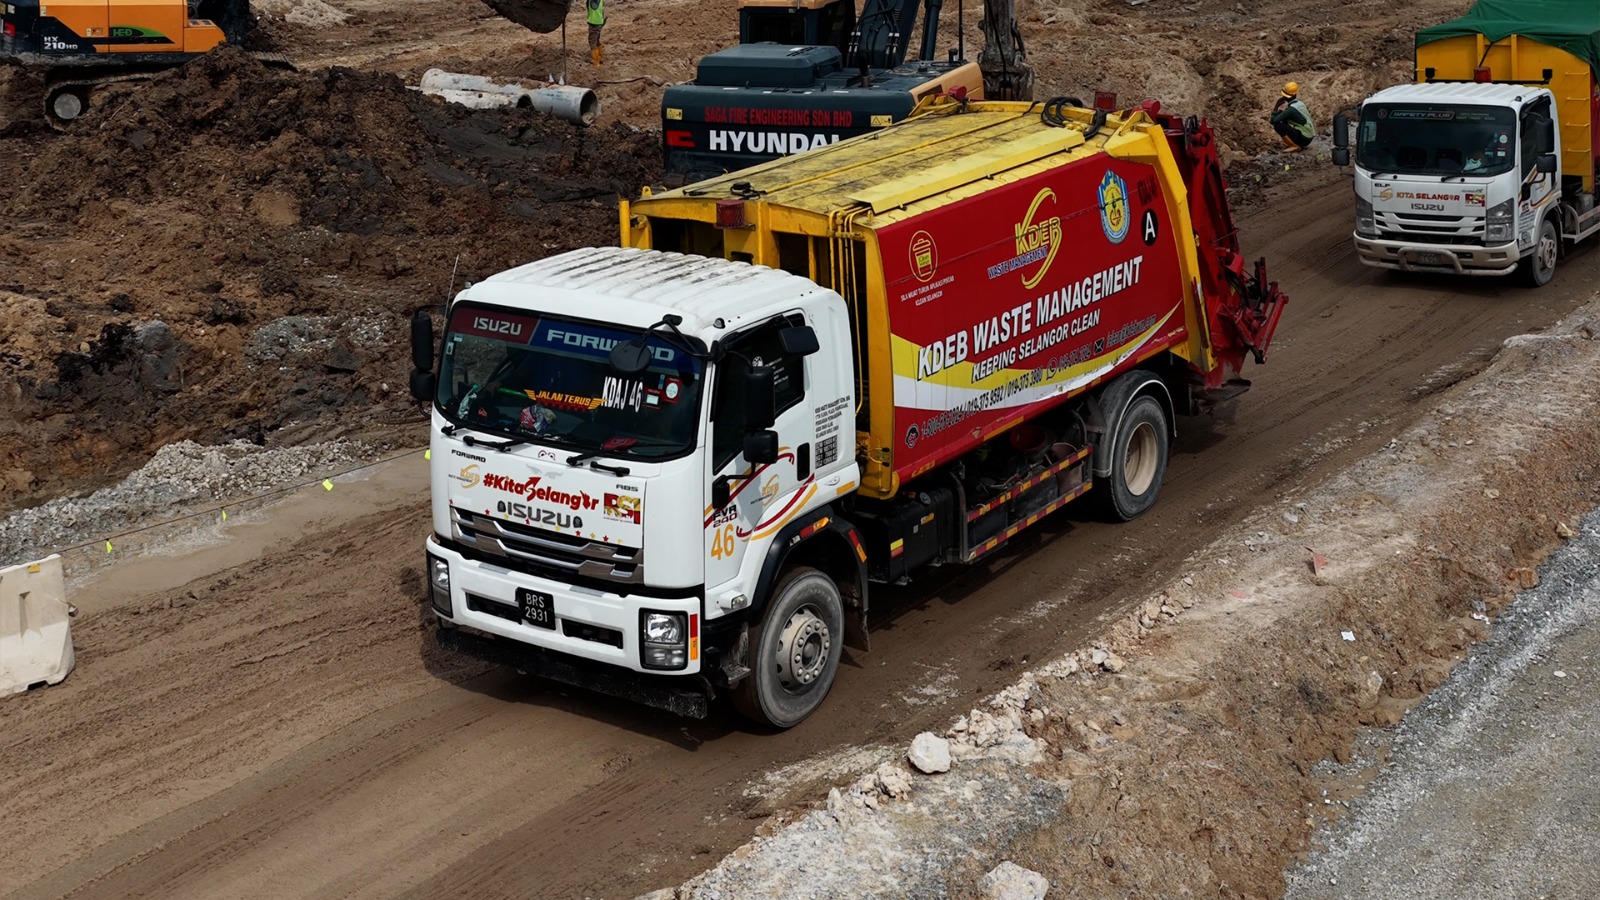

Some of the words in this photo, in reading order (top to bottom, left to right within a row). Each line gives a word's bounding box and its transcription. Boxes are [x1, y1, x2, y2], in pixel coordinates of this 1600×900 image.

[43, 41, 78, 50] 210HD
[704, 106, 726, 123] SAGA
[729, 108, 748, 124] FIRE
[750, 108, 810, 126] ENGINEERING
[812, 110, 831, 127] SDN
[833, 111, 852, 127] BHD
[1396, 191, 1415, 199] KITA
[1410, 202, 1445, 212] ISUZU
[1014, 216, 1063, 256] KDEB
[1144, 211, 1157, 242] A
[987, 261, 1009, 280] WASTE
[1009, 245, 1049, 272] MANAGEMENT
[473, 316, 522, 336] ISUZU
[917, 333, 968, 381] KDEB
[973, 302, 1032, 355] WASTE
[1036, 256, 1143, 327] MANAGEMENT
[547, 329, 675, 362] FORWD
[971, 347, 1016, 383] KEEPING
[1018, 325, 1069, 360] SELANGOR
[1070, 309, 1101, 336] CLEAN
[535, 390, 563, 402] JALAN
[564, 394, 591, 406] TERUS
[601, 376, 629, 410] KDAJ
[629, 380, 643, 413] 46
[451, 449, 487, 463] FORWARD
[616, 483, 639, 492] ABS
[507, 500, 571, 528] ISUZU
[712, 504, 737, 522] FVR
[713, 512, 737, 528] 240
[710, 523, 735, 561] 46
[525, 592, 545, 609] BRS
[525, 605, 548, 623] 2931
